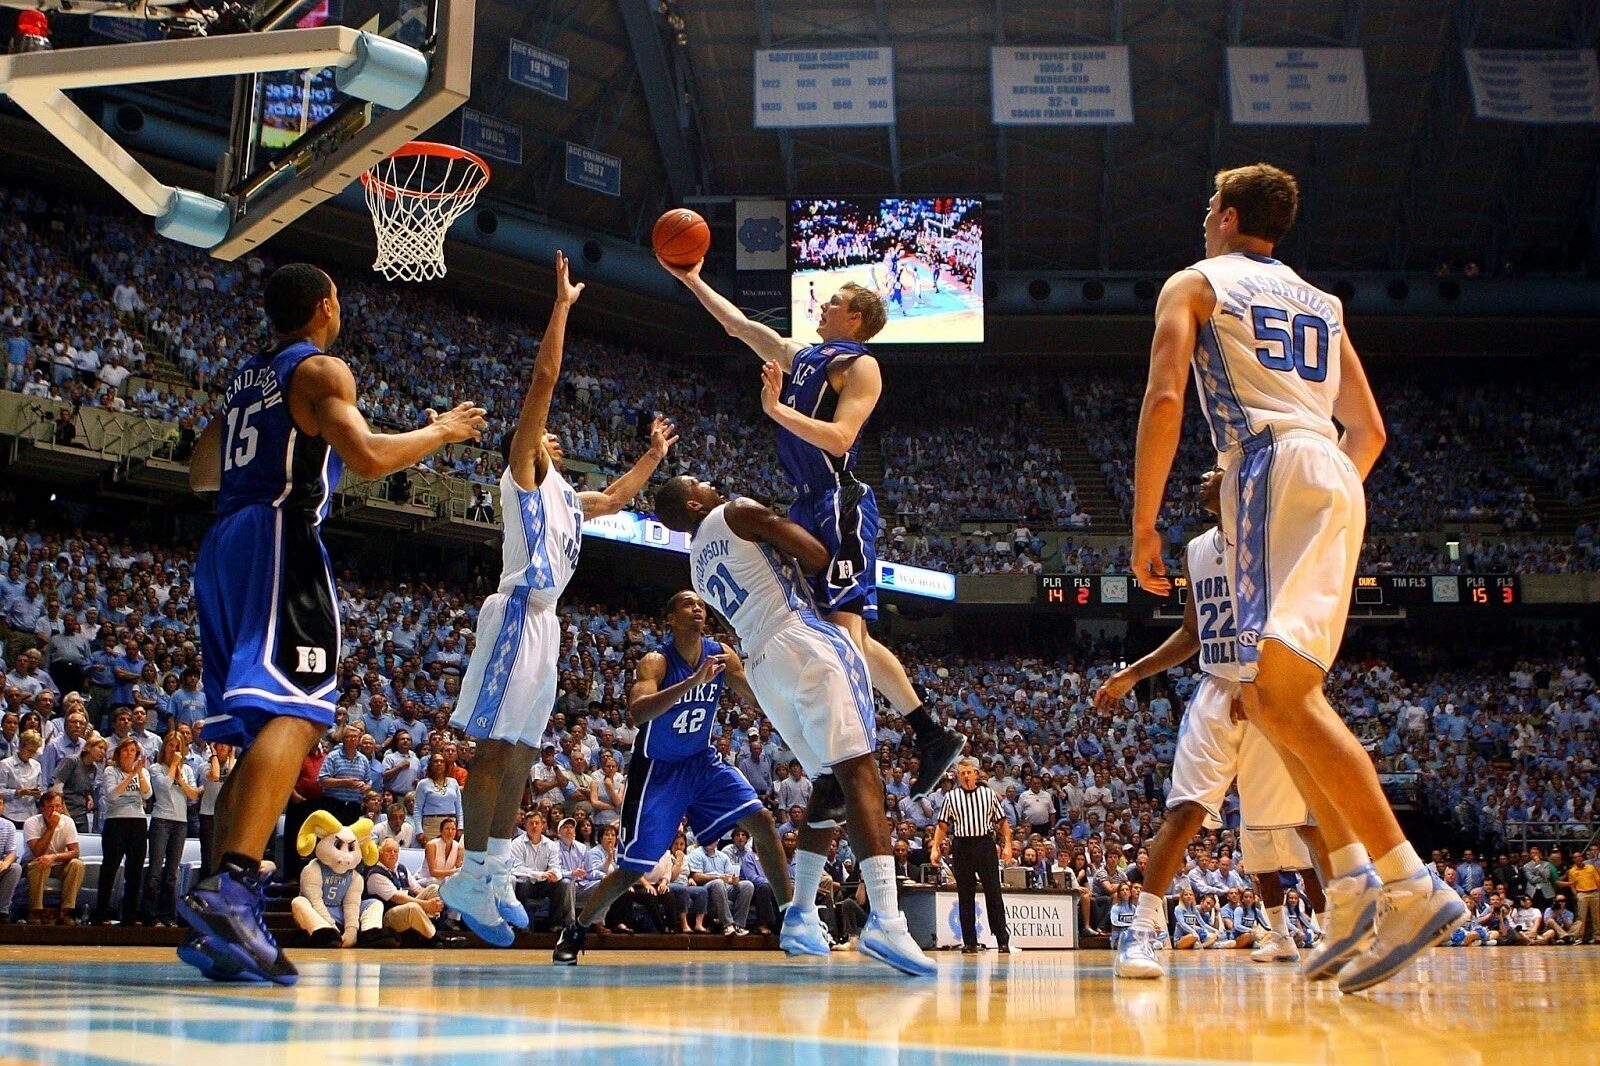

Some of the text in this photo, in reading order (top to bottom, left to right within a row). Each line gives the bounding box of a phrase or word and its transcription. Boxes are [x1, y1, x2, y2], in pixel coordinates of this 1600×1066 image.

[583, 161, 605, 177] 1987
[1221, 274, 1341, 336] HANSBROUGH
[1250, 305, 1329, 383] 50
[224, 400, 263, 472] 15
[696, 540, 730, 595] THOMPSON
[1043, 577, 1062, 588] PLR
[1074, 577, 1091, 588] FLS
[1358, 577, 1378, 587] DUKE
[1392, 577, 1427, 588] TM FLS
[1466, 577, 1486, 588] PLR
[1497, 577, 1514, 588] FLS
[706, 562, 750, 621] 21
[1048, 588, 1064, 603] 14
[1076, 587, 1090, 604] 2
[1472, 587, 1488, 603] 15
[1502, 587, 1514, 604] 3
[1200, 600, 1237, 641] 22
[672, 707, 707, 734] 42
[324, 876, 347, 887] NORTH
[327, 886, 339, 900] 5
